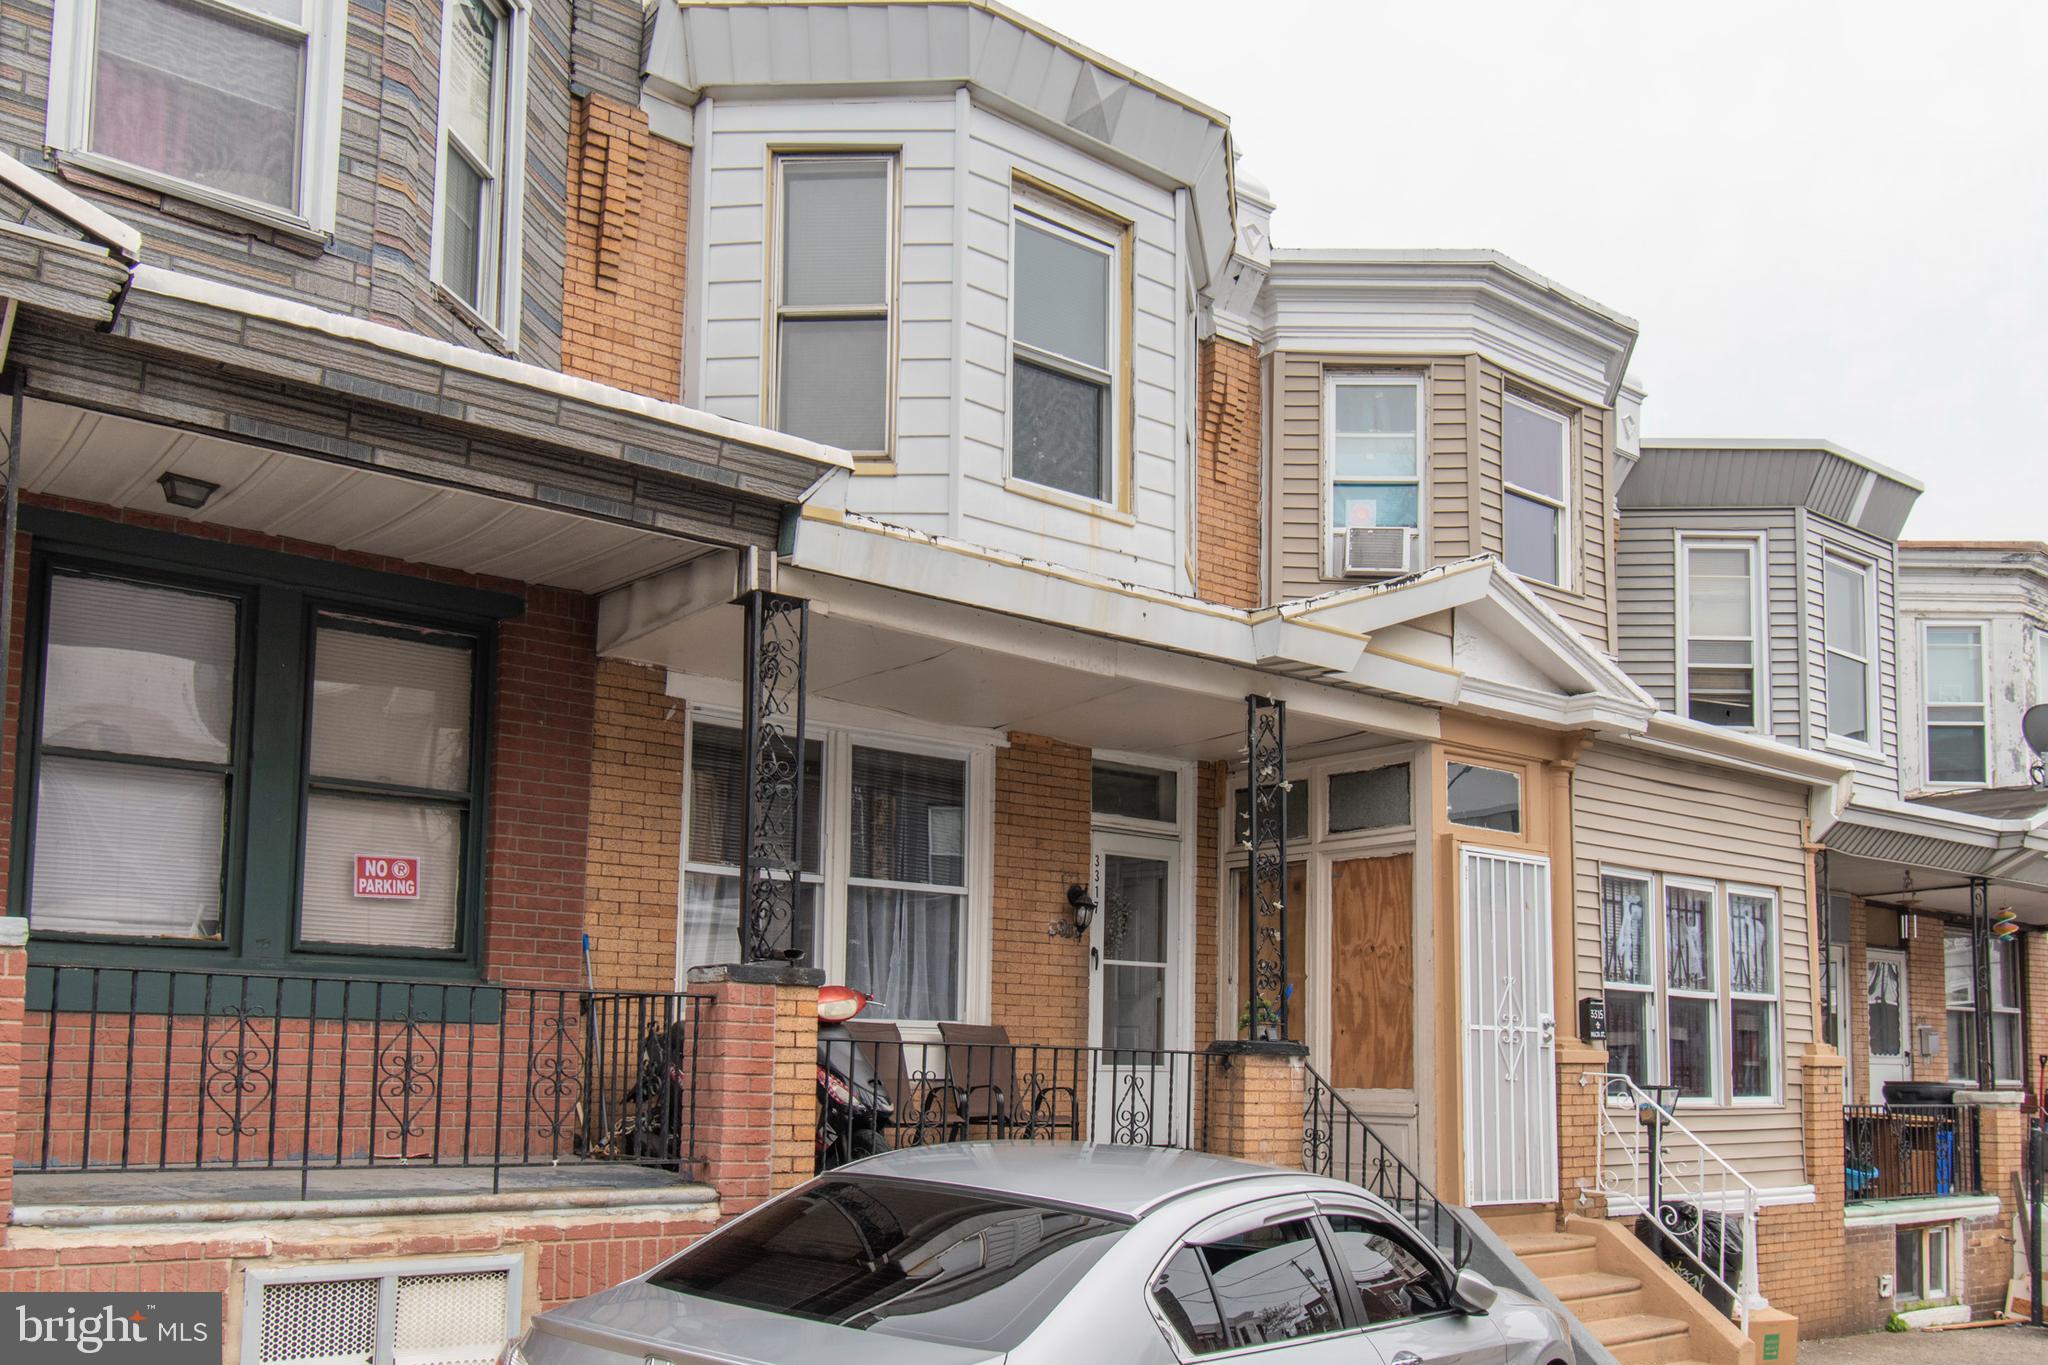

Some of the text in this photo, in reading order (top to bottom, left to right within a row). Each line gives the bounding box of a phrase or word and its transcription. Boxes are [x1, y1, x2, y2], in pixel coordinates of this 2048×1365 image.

[365, 860, 388, 877] NO
[358, 878, 415, 895] PARKING
[1590, 1009, 1604, 1019] 3315
